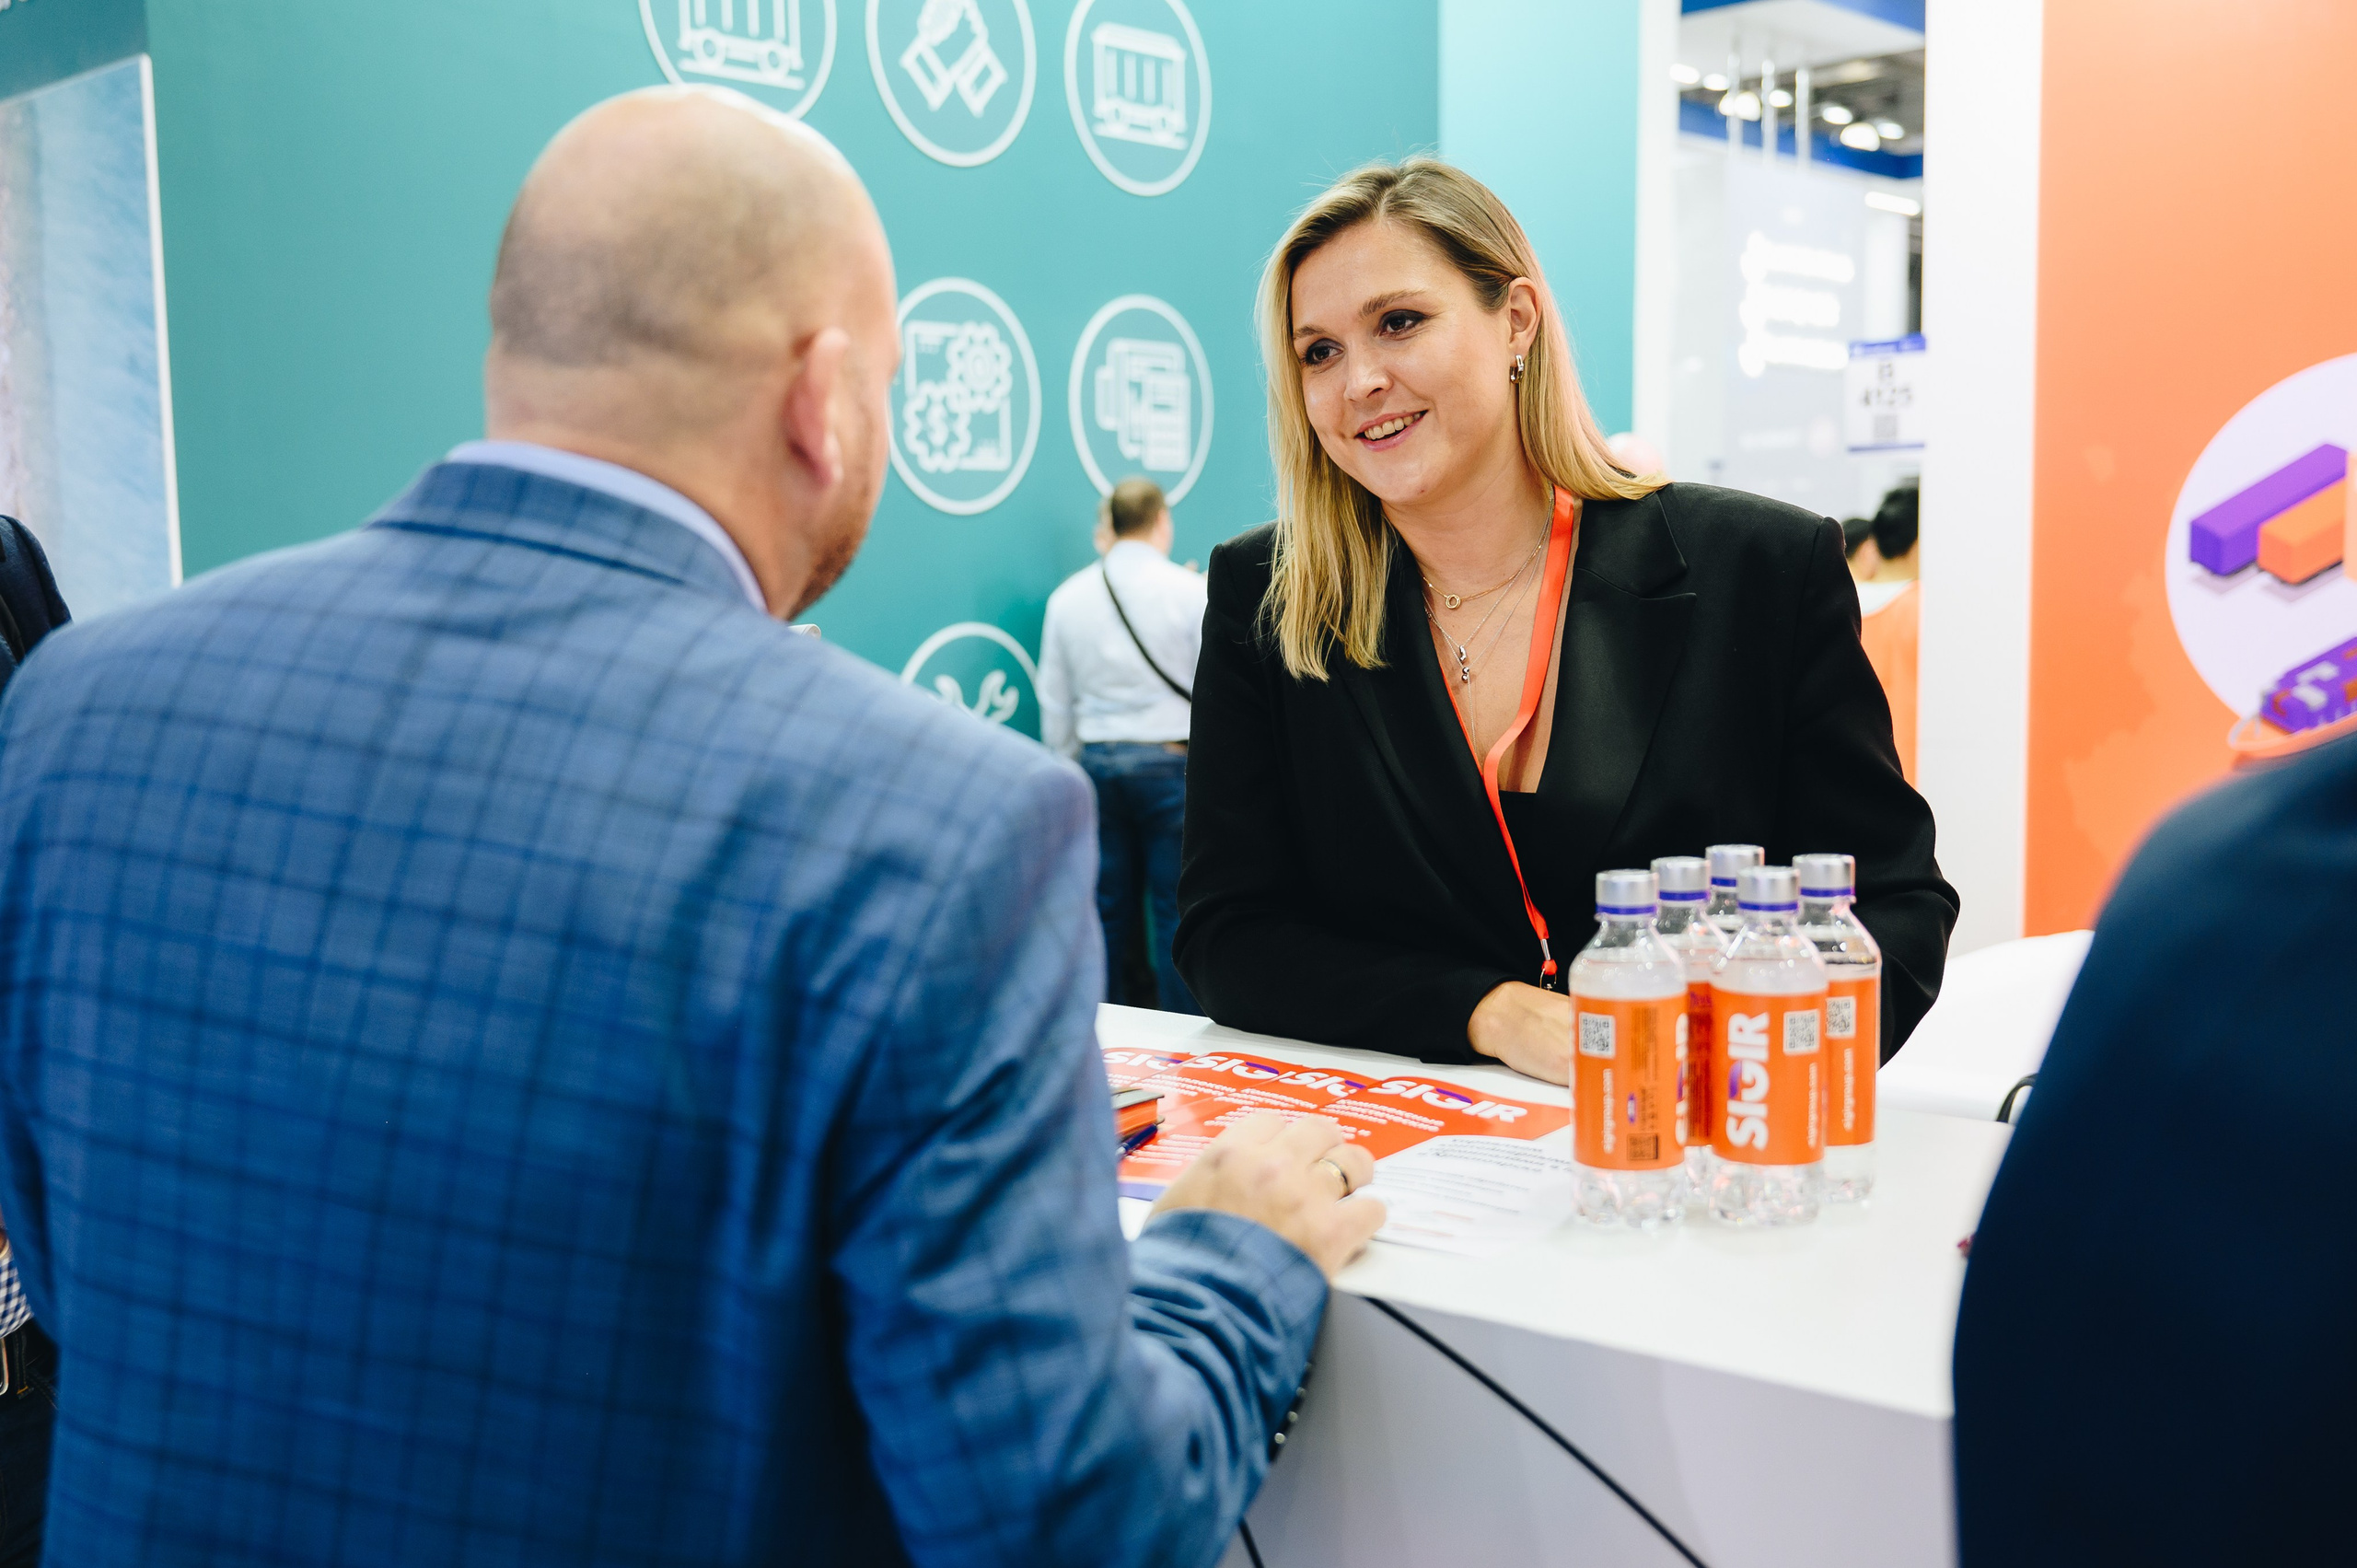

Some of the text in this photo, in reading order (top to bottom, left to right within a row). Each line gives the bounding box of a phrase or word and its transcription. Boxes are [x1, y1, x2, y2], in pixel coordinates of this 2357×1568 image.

[1184, 1055, 1291, 1082] SIG
[1726, 1011, 1770, 1151] SIGIR
[1368, 1080, 1527, 1123] SIGIR
